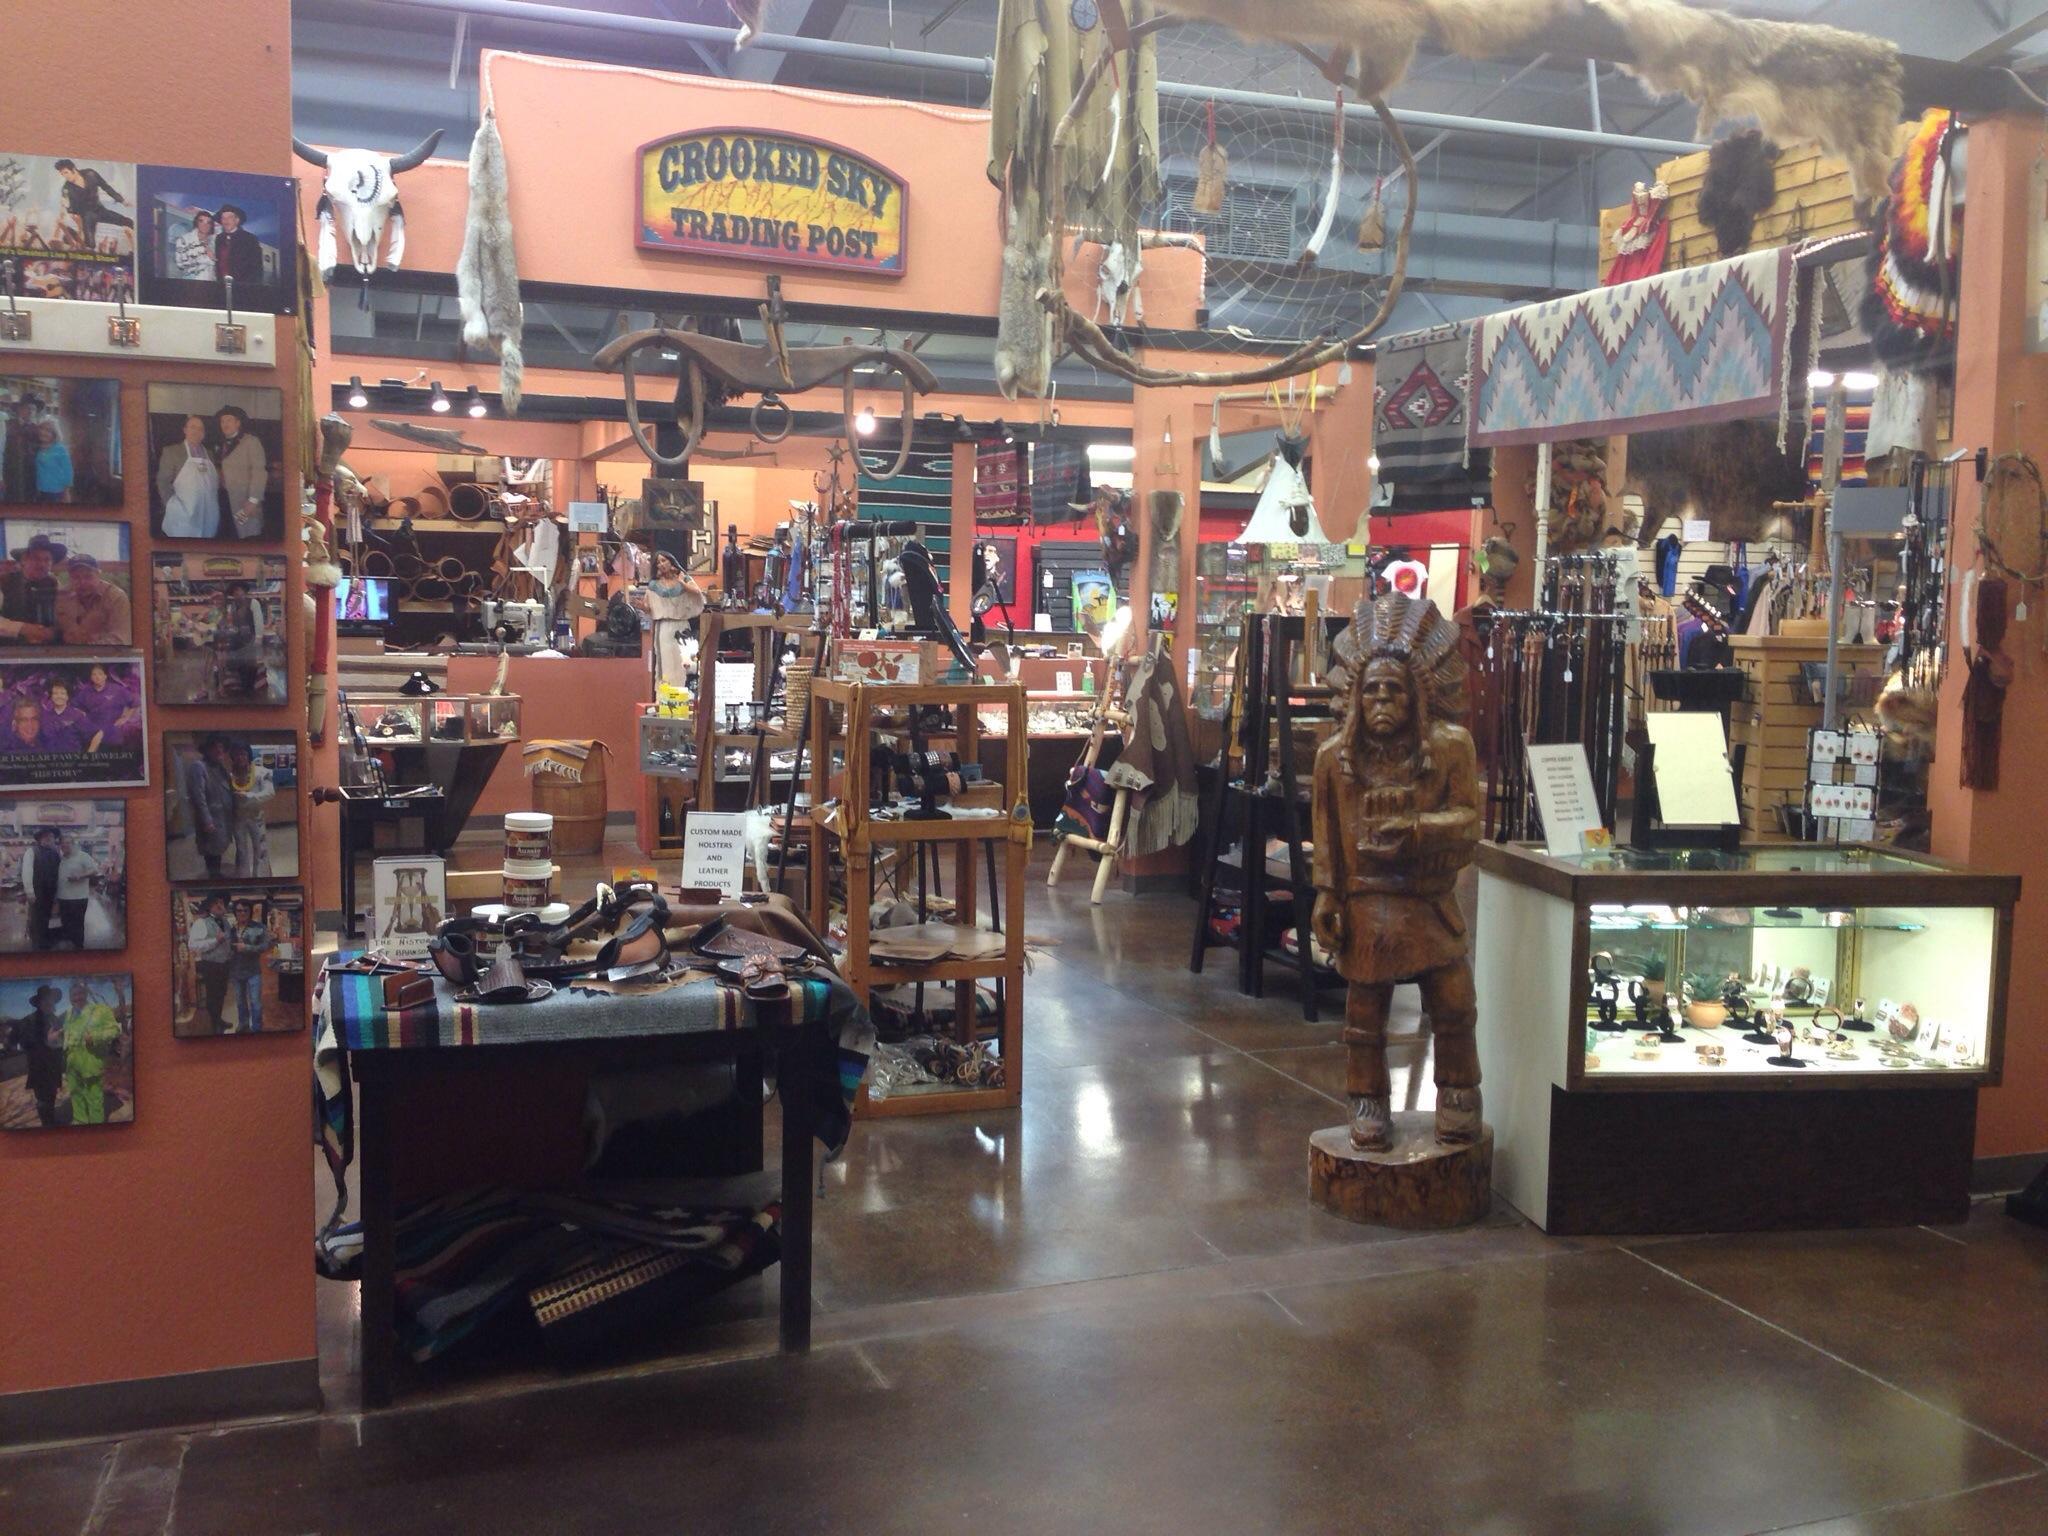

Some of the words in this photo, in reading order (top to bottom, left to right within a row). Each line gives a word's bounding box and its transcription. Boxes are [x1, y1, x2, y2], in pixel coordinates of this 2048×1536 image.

[658, 137, 820, 194] CROOKED
[827, 155, 892, 219] SKY
[671, 207, 800, 252] TRADING
[808, 223, 878, 260] POST
[10, 752, 51, 762] DOLLAR
[52, 752, 81, 761] PAWN
[91, 751, 135, 762] JEWELRY
